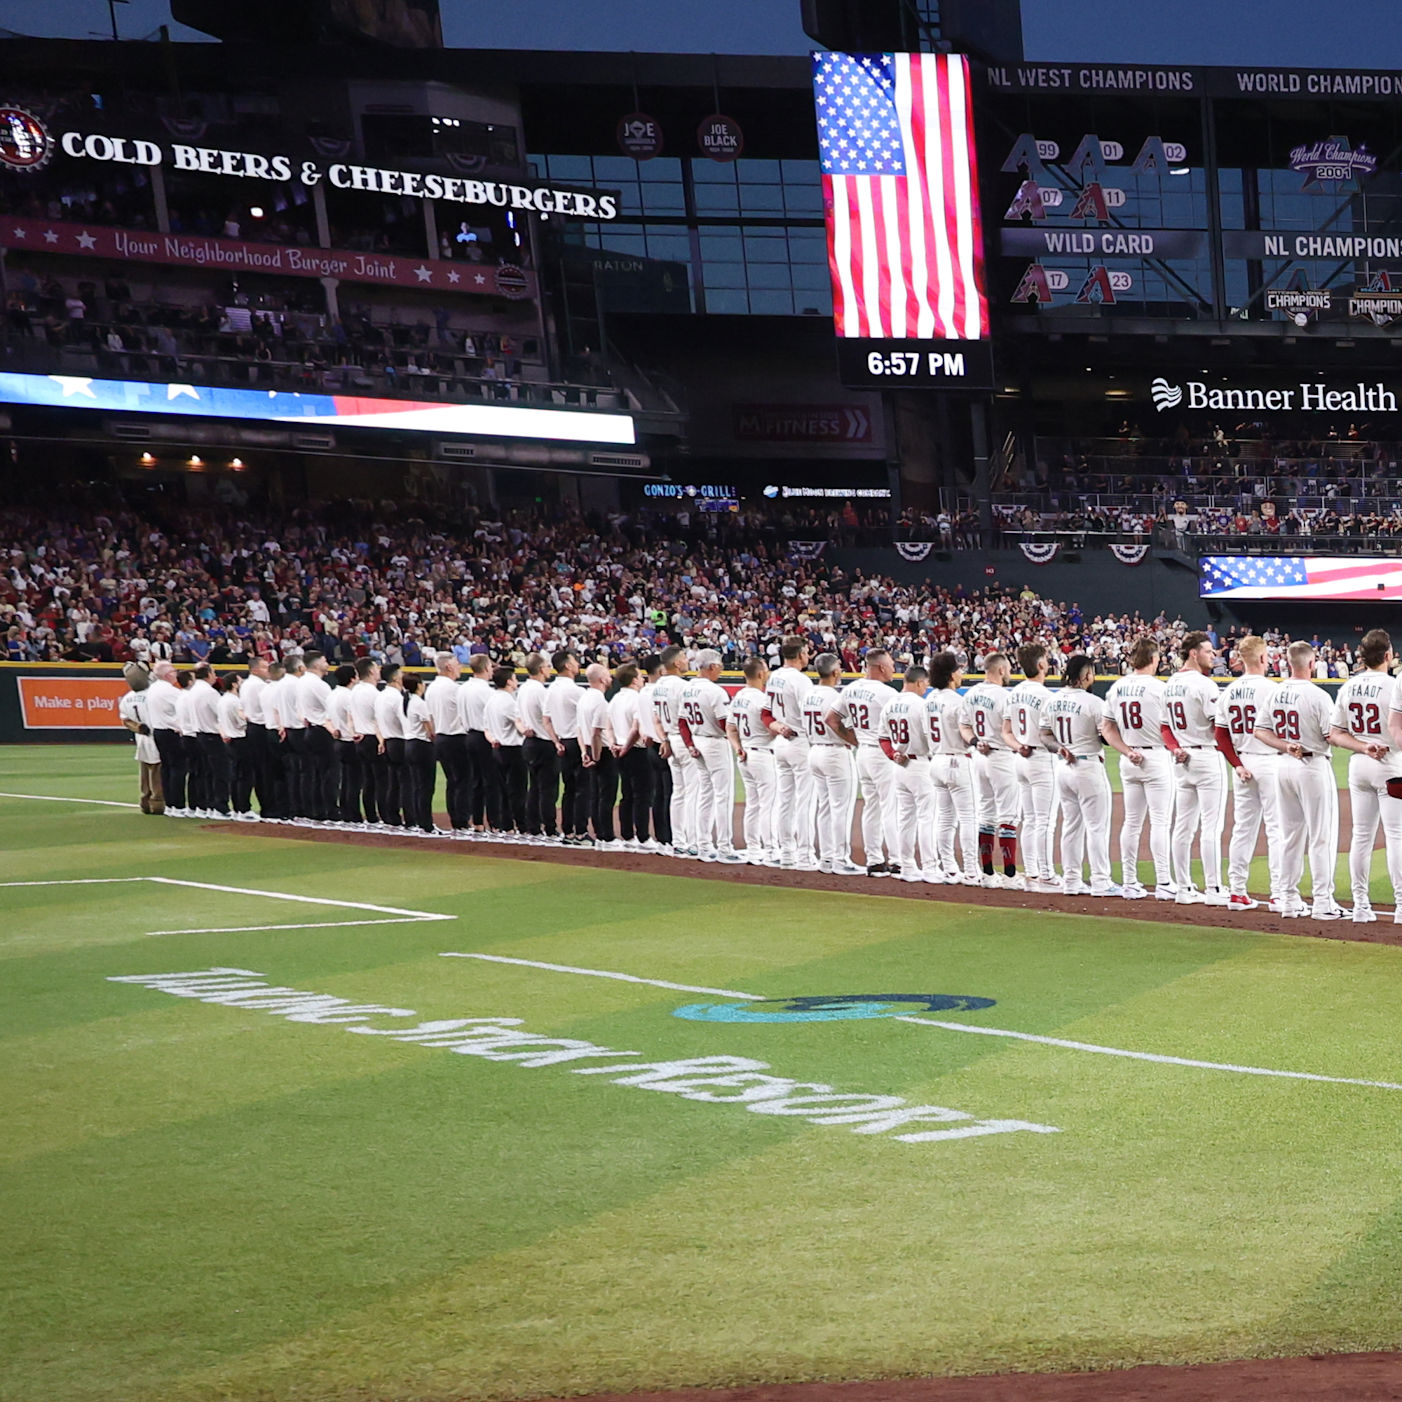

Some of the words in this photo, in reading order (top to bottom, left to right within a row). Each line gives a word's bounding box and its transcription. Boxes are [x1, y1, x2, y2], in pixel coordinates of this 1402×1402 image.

[987, 67, 1012, 87] NL
[1017, 68, 1073, 88] WEST
[1079, 69, 1194, 91] CHAMPIONS
[1237, 72, 1301, 93] WORLD
[704, 135, 738, 147] BLACK
[710, 124, 729, 135] JOE
[1103, 143, 1119, 158] 01
[1165, 145, 1183, 159] 02
[1290, 143, 1320, 164] World
[1324, 143, 1377, 168] Champions
[62, 132, 162, 166] COLD
[171, 144, 292, 182] BEERS
[300, 162, 322, 186] &
[328, 164, 617, 219] CHEESEBURGERS
[1316, 166, 1352, 180] 2001
[1042, 190, 1058, 203] 07
[1106, 191, 1120, 204] 11
[1044, 232, 1095, 253] WILD
[1101, 234, 1154, 255] CARD
[1264, 236, 1290, 256] NL
[114, 232, 158, 256] Your
[164, 238, 282, 269] Neighborhood
[285, 248, 348, 276] Burger
[353, 256, 397, 279] Joint
[593, 260, 644, 272] RATON
[1050, 274, 1064, 287] 17
[1112, 274, 1130, 288] 23
[1267, 294, 1331, 309] CHAMPIONS
[867, 352, 919, 376] 6:57
[928, 353, 965, 376] PM
[1187, 381, 1294, 411] Banner
[1300, 382, 1398, 412] Health
[701, 485, 732, 498] GRILL
[34, 695, 73, 709] Make
[75, 699, 84, 709] a
[87, 696, 114, 711] play
[1116, 685, 1146, 698] MILLER
[1230, 687, 1256, 701] SMITH
[1274, 691, 1300, 706] KELLY
[132, 704, 142, 723] 1
[654, 701, 672, 724] 70
[684, 702, 704, 725] 36
[767, 691, 786, 718] 74
[1120, 701, 1143, 730] 18
[1166, 701, 1188, 730] 19
[733, 713, 750, 737] 73
[804, 711, 826, 736] 75
[849, 703, 870, 730] 82
[975, 710, 985, 737] 8
[1018, 708, 1027, 736] 9
[1229, 705, 1256, 734] 26
[1273, 709, 1300, 740] 29
[1349, 702, 1382, 734] 32
[888, 719, 910, 744] 88
[929, 716, 941, 743] 5
[1056, 716, 1073, 744] 11
[570, 1054, 1063, 1143] RESORT
